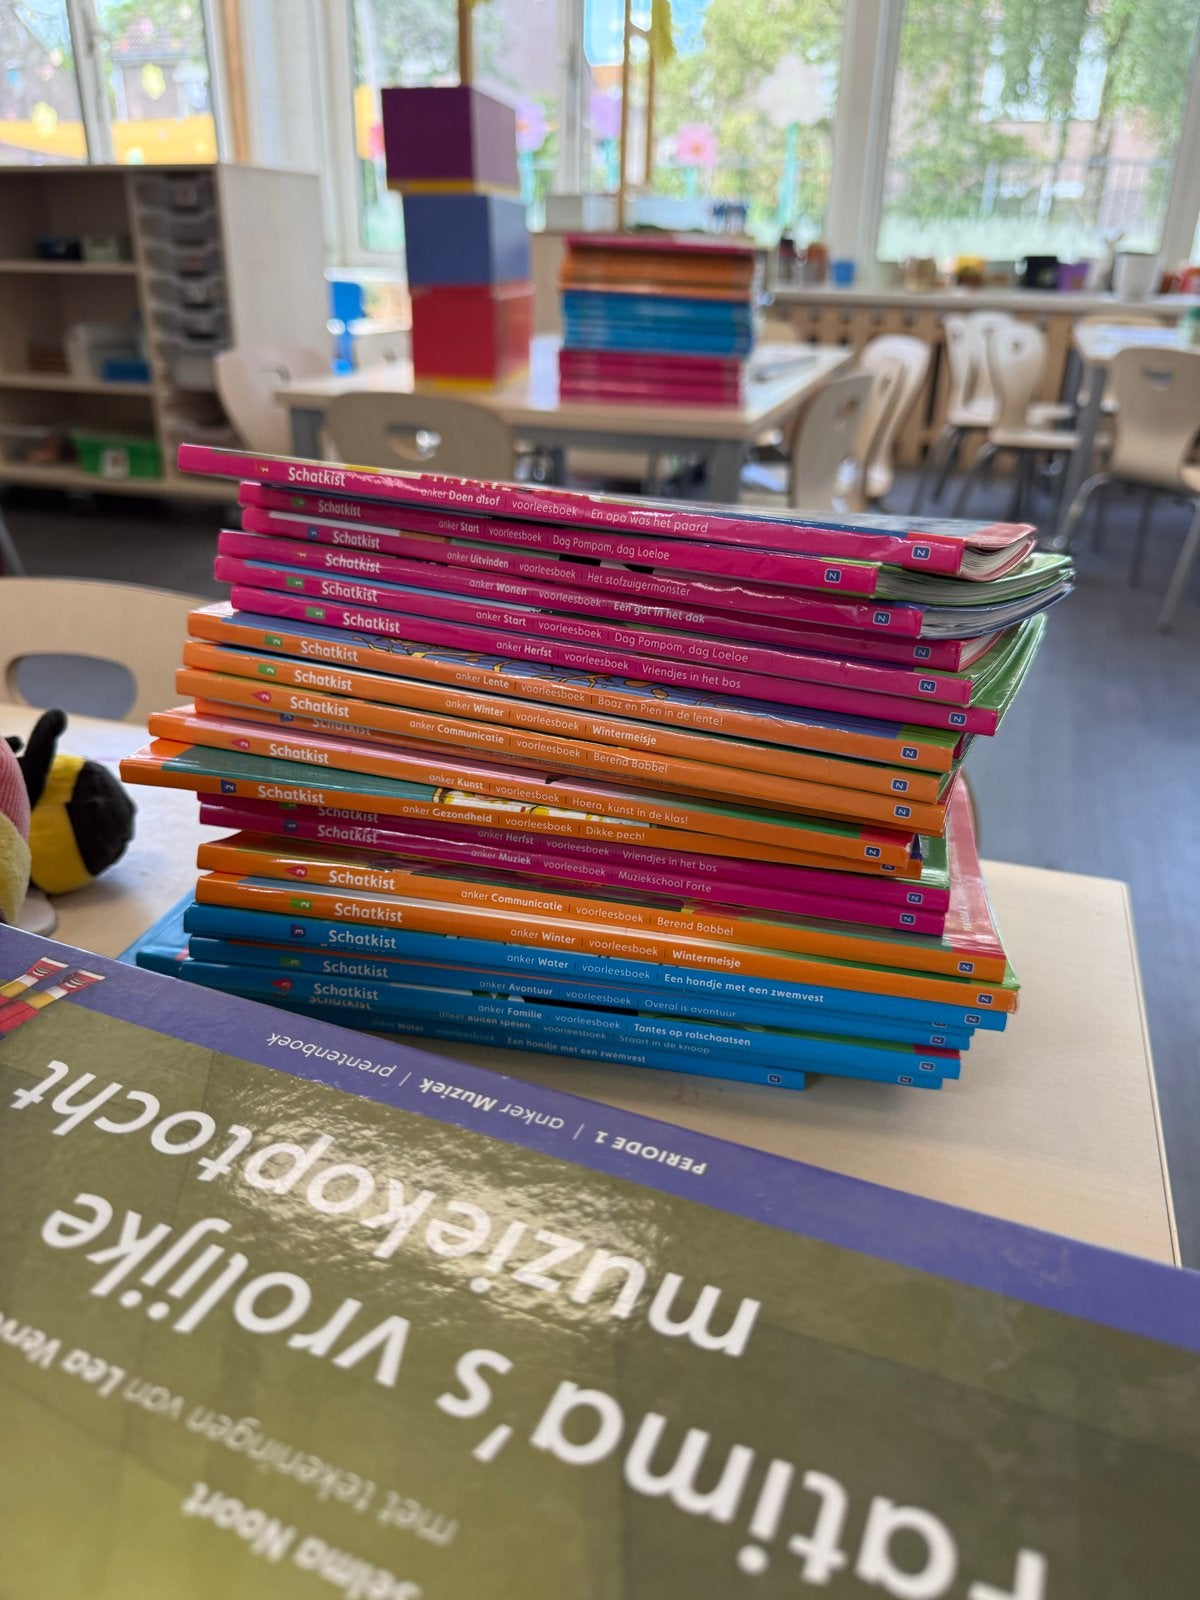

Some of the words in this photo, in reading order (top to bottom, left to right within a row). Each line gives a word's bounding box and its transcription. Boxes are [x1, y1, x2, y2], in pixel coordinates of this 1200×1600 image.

[288, 467, 345, 487] Schatkist
[420, 488, 445, 499] anker
[448, 490, 474, 503] Doen
[476, 494, 500, 507] alsof
[511, 501, 577, 516] voorleesboek
[590, 508, 604, 520] En
[606, 513, 627, 524] opa
[630, 516, 650, 526] was
[652, 516, 671, 528] het
[673, 522, 708, 533] paard
[318, 500, 361, 517] Schatkist
[438, 520, 459, 531] anker
[460, 522, 480, 534] Start
[488, 529, 542, 542] voorleesboek
[552, 535, 570, 548] Dag
[572, 538, 614, 554] Pompom,
[616, 544, 635, 557] dag
[637, 547, 670, 560] Loeloe
[325, 553, 380, 573] Schatkist
[469, 579, 495, 591] anker
[496, 582, 527, 596] Wonen
[539, 591, 600, 607] voorleesboek
[613, 600, 632, 612] Een
[633, 605, 652, 616] gat
[653, 607, 664, 617] in
[665, 608, 682, 620] het
[685, 611, 705, 623] dak
[333, 531, 380, 550] Schatkist
[446, 552, 469, 563] anker
[470, 554, 509, 569] Uitvinden
[519, 564, 576, 579] voorleesboek
[587, 572, 603, 583] Het
[605, 576, 691, 597] stofzuigermonster
[322, 581, 378, 602] Schatkist
[475, 611, 501, 624] anker
[503, 614, 526, 628] Start
[538, 622, 602, 640] voorleesboek
[614, 632, 636, 647] Dag
[638, 636, 685, 655] Pompom,
[688, 644, 709, 659] dag
[712, 648, 748, 663] Loeloe
[342, 612, 400, 633] Schatkist
[496, 641, 522, 653] anker
[524, 644, 552, 658] Herfst
[563, 653, 629, 670] voorleesboek
[641, 663, 688, 681] Vriendjes
[690, 672, 700, 682] in
[702, 673, 719, 685] het
[722, 676, 741, 689] bos
[294, 670, 352, 691] Schatkist
[444, 700, 471, 713] anker
[472, 703, 504, 718] Winter
[516, 713, 579, 731] voorleesboek
[592, 724, 656, 746] Wintermeisje
[300, 641, 358, 662] Schatkist
[455, 672, 481, 685] anker
[483, 675, 509, 689] Lente
[521, 685, 584, 702] voorleesboek
[598, 695, 622, 709] Boaz
[624, 702, 638, 711] en
[640, 702, 662, 716] Pien
[664, 707, 674, 718] in
[676, 709, 690, 720] de
[692, 711, 723, 726] lente!
[290, 696, 349, 718] Schatkist
[409, 720, 435, 732] anker
[437, 723, 504, 744] Communicatie
[516, 740, 581, 758] voorleesboek
[593, 751, 628, 766] Berend
[631, 758, 668, 774] Babbel
[258, 785, 324, 804] Schatkist
[402, 805, 430, 817] anker
[432, 807, 492, 824] Gezondheid
[505, 817, 572, 833] voorleesboek
[585, 824, 614, 837] Dikke
[616, 830, 645, 841] pech!
[269, 743, 329, 764] Schatkist
[428, 773, 455, 786] anker
[456, 776, 484, 790] Kunst
[495, 785, 559, 803] voorleesboek
[572, 795, 605, 812] Hoera,
[608, 801, 634, 815] kunst
[636, 807, 647, 817] in
[649, 808, 662, 820] de
[664, 811, 688, 824] klas!
[318, 806, 379, 824] Schatkist
[317, 825, 378, 844] Schatkist
[470, 848, 496, 860] anker
[497, 851, 531, 866] Muziek
[542, 860, 606, 877] voorleesboek
[618, 869, 683, 889] Muziekschool
[686, 879, 711, 893] Forte
[328, 870, 396, 890] Schatkist
[460, 890, 488, 902] anker
[490, 893, 563, 912] Communicatie
[575, 907, 643, 924] voorleesboek
[656, 916, 693, 931] Berend
[696, 922, 734, 937] Babbel
[334, 903, 403, 923] Schatkist
[510, 928, 538, 940] anker
[541, 931, 575, 945] Winter
[588, 939, 658, 956] voorleesboek
[672, 948, 741, 968] Wintermeisje
[322, 960, 388, 978] Schatkist
[479, 979, 505, 990] anker
[508, 981, 552, 996] Avontuur
[565, 990, 631, 1005] voorleesboek
[644, 997, 677, 1011] Overal
[680, 1002, 687, 1012] is
[690, 1005, 736, 1017] avontuur
[328, 929, 396, 949] Schatkist
[506, 954, 534, 966] anker
[538, 956, 568, 970] Water
[581, 964, 650, 981] voorleesboek
[664, 973, 684, 985] Een
[686, 975, 723, 992] hondje
[725, 983, 745, 993] met
[748, 986, 767, 996] een
[770, 989, 824, 1003] zwemvest
[313, 983, 379, 1001] Schatkist
[477, 1003, 504, 1015] anker
[507, 1005, 542, 1020] Familie
[554, 1014, 620, 1030] voorleesboek
[634, 1022, 666, 1035] Tantes
[669, 1029, 682, 1040] op
[685, 1029, 751, 1046] rolschaatsen
[265, 1032, 397, 1078] prentenboek
[418, 1077, 498, 1112] Muziek
[499, 1103, 565, 1130] anker
[594, 1130, 609, 1144] 1
[612, 1136, 707, 1175] PERIODE
[10, 1060, 761, 1357] muziekoptocht
[41, 1193, 410, 1388] vrolijke
[61, 1348, 126, 1398] Lea
[122, 1376, 186, 1420] van
[186, 1405, 376, 1511] tekeningen
[182, 1481, 297, 1562] Noort
[377, 1490, 459, 1546] met
